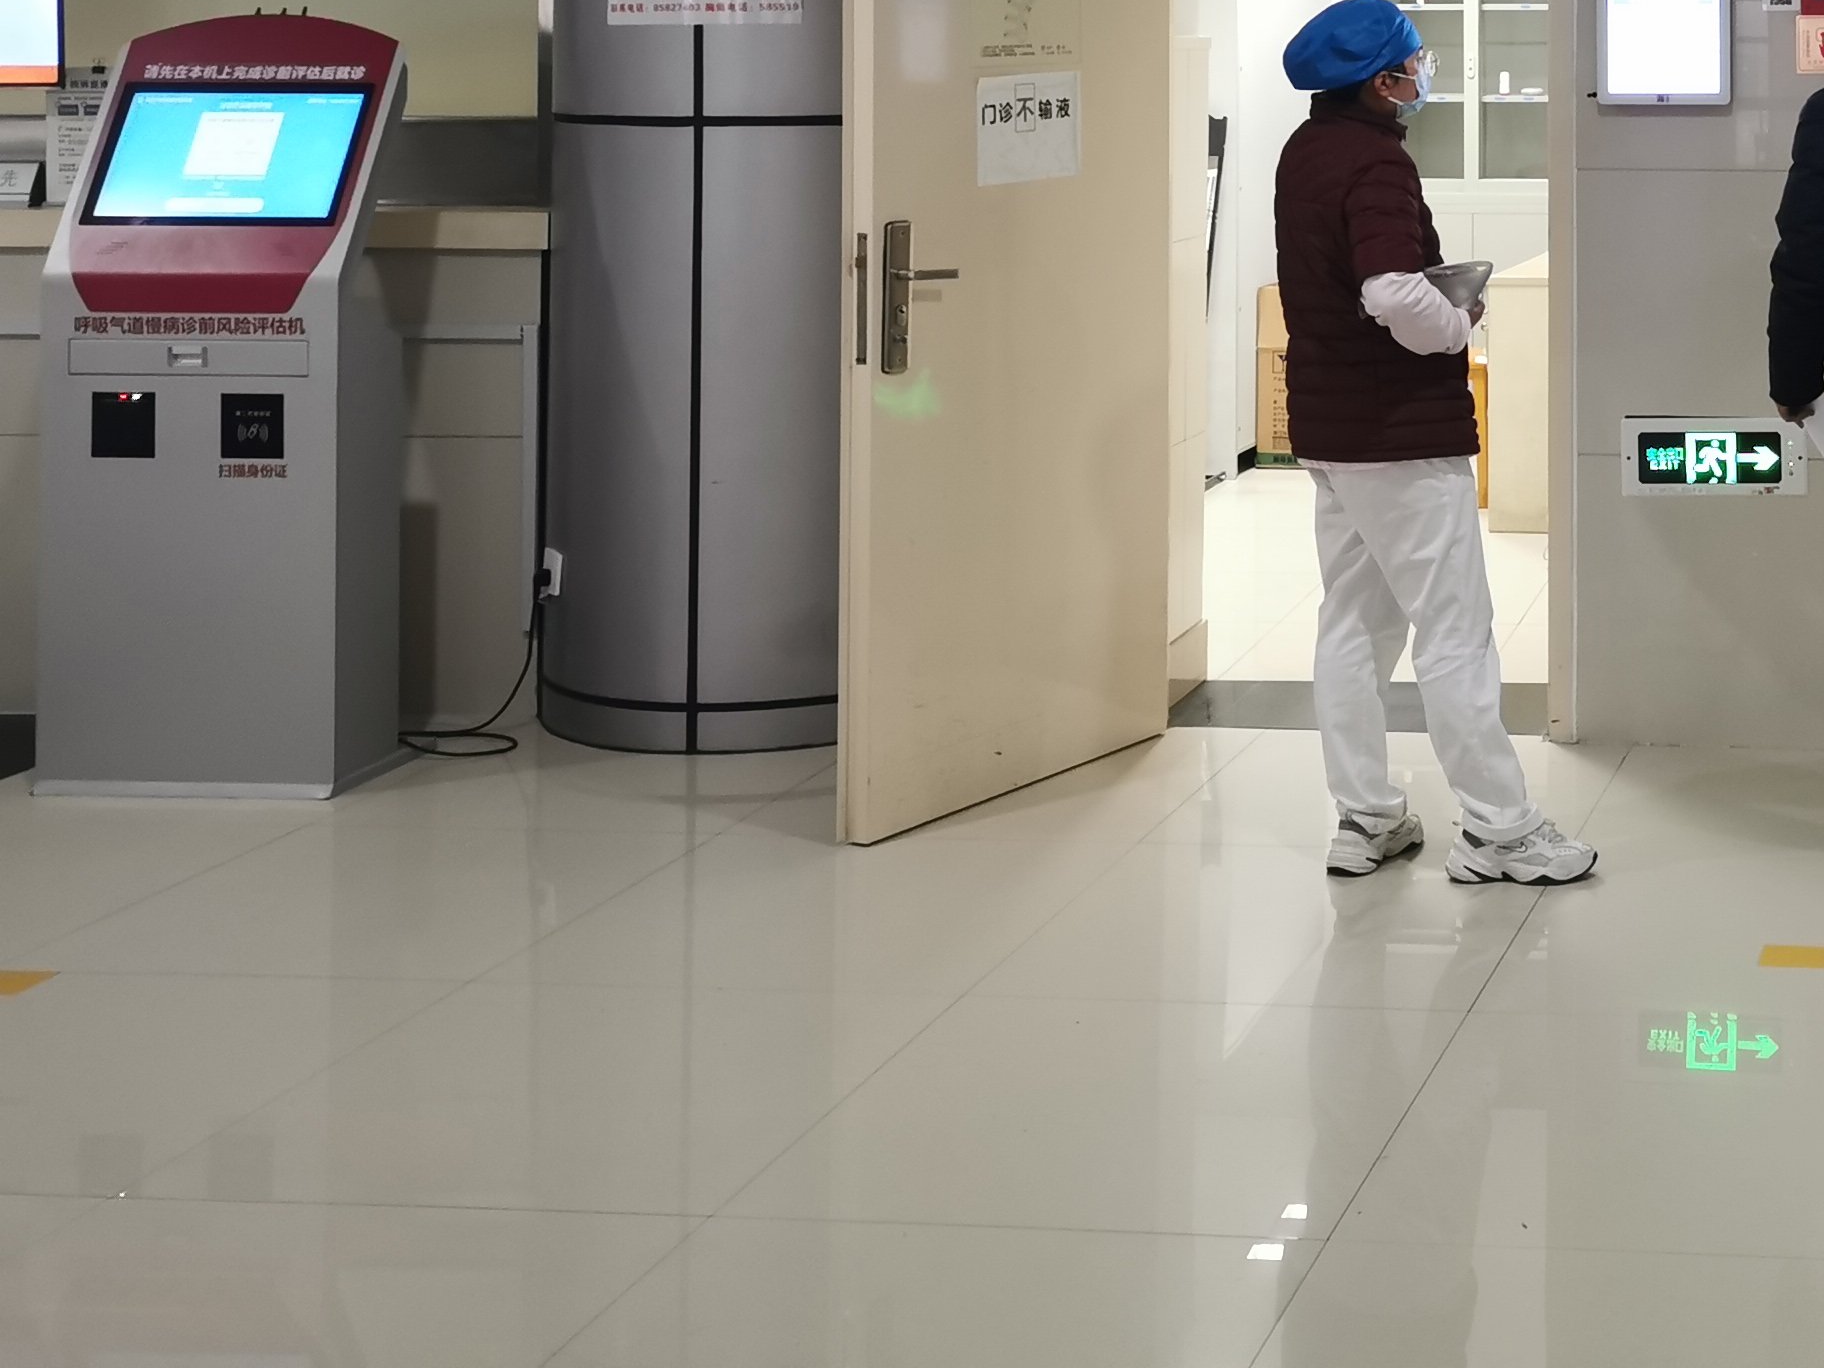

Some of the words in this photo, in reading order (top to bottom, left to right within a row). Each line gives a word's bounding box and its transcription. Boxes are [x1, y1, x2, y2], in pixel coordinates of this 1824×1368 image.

[982, 96, 1070, 126] 门诊不输液
[74, 316, 306, 335] 呼吸气道慢病诊前风险评估机
[219, 463, 288, 479] 扫描身份证
[1649, 459, 1681, 471] EXIT
